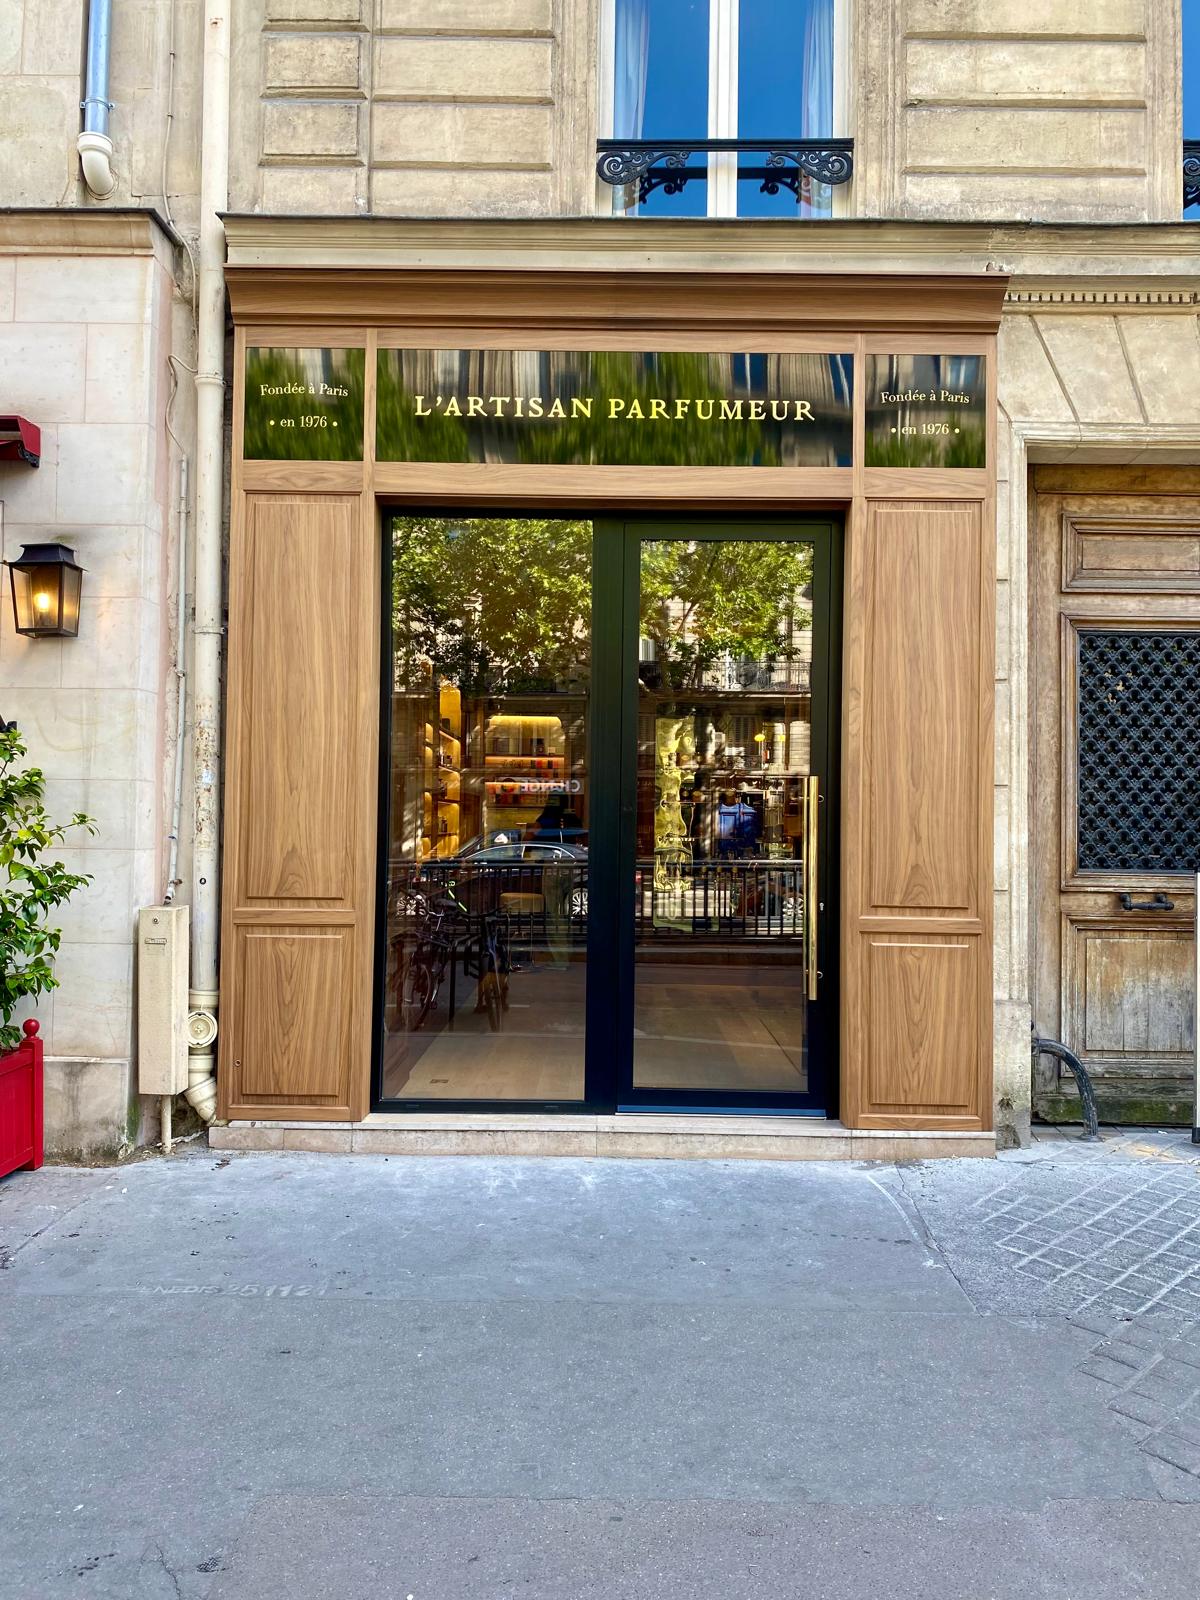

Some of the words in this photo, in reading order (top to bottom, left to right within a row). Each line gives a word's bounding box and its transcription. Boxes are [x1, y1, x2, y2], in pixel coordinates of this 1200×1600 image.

[260, 382, 306, 396] Fondée
[308, 383, 315, 394] à
[319, 382, 349, 397] Paris
[881, 389, 927, 404] Fondée
[929, 389, 937, 401] à
[940, 389, 970, 404] Paris
[415, 395, 593, 419] L'ARTISAN
[607, 397, 816, 422] PARFUMEUR
[280, 418, 295, 427] en
[300, 415, 328, 428] 1976
[901, 425, 917, 435] en
[921, 423, 950, 435] 1976
